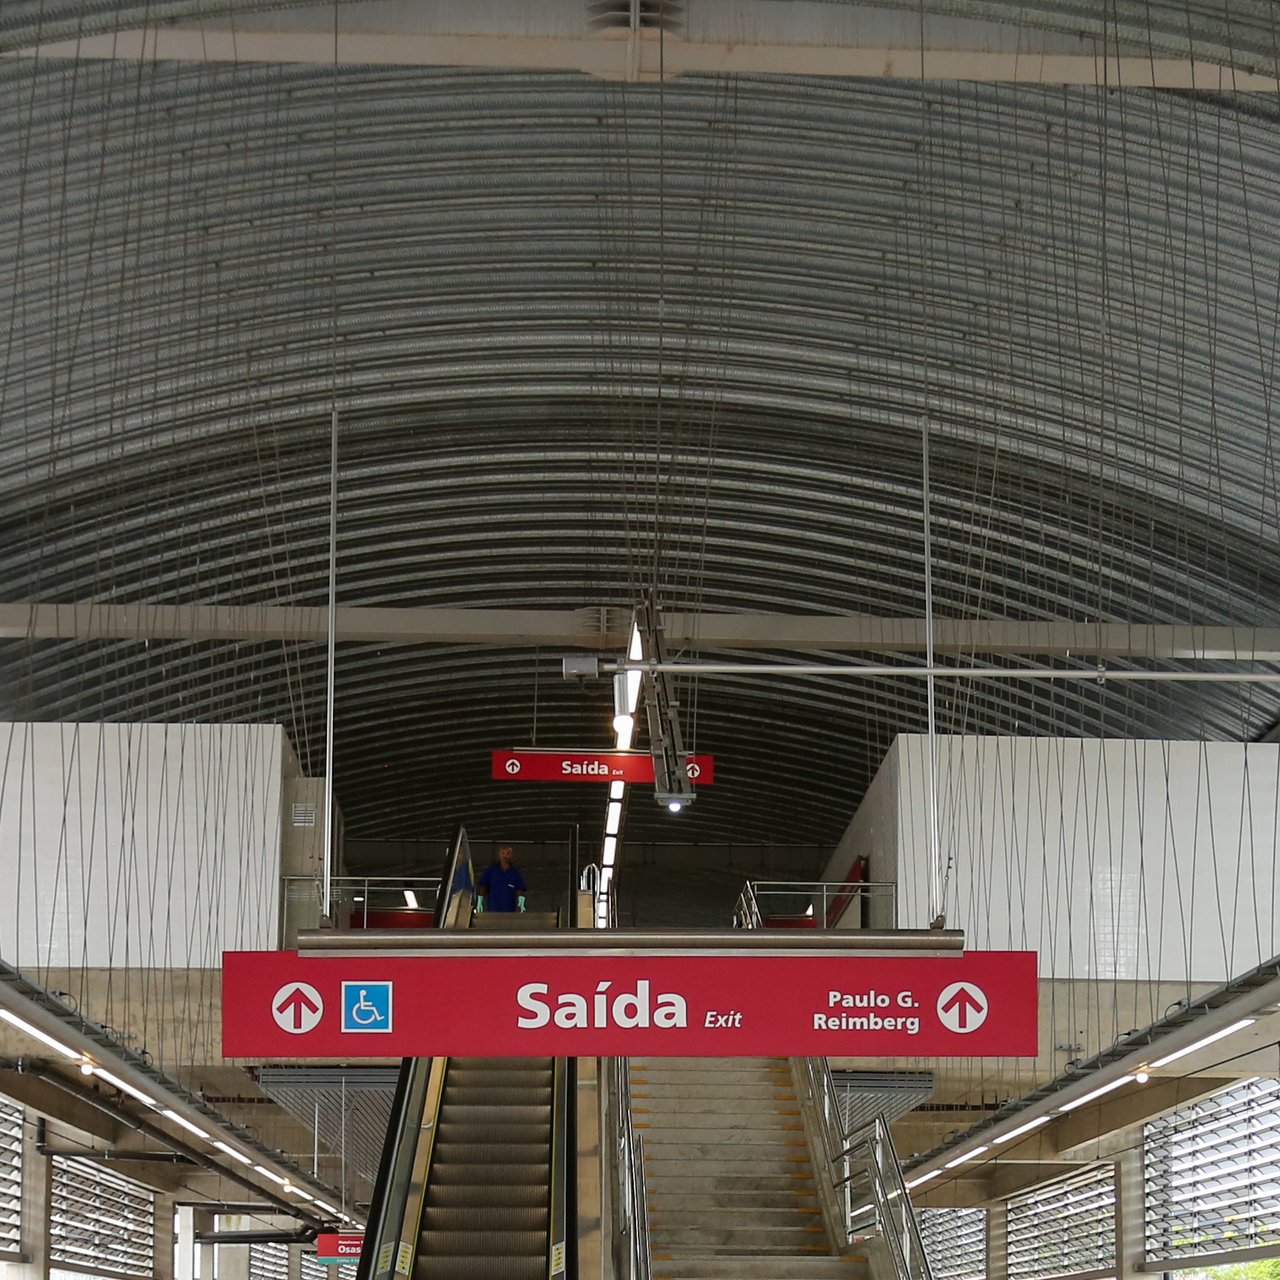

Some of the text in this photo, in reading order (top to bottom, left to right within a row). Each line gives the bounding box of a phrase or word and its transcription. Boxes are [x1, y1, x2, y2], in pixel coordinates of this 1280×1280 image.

[561, 760, 609, 775] Saída
[516, 979, 743, 1029] Saída Exit
[828, 990, 919, 1007] Paulo G.
[813, 1012, 919, 1034] Reimberg
